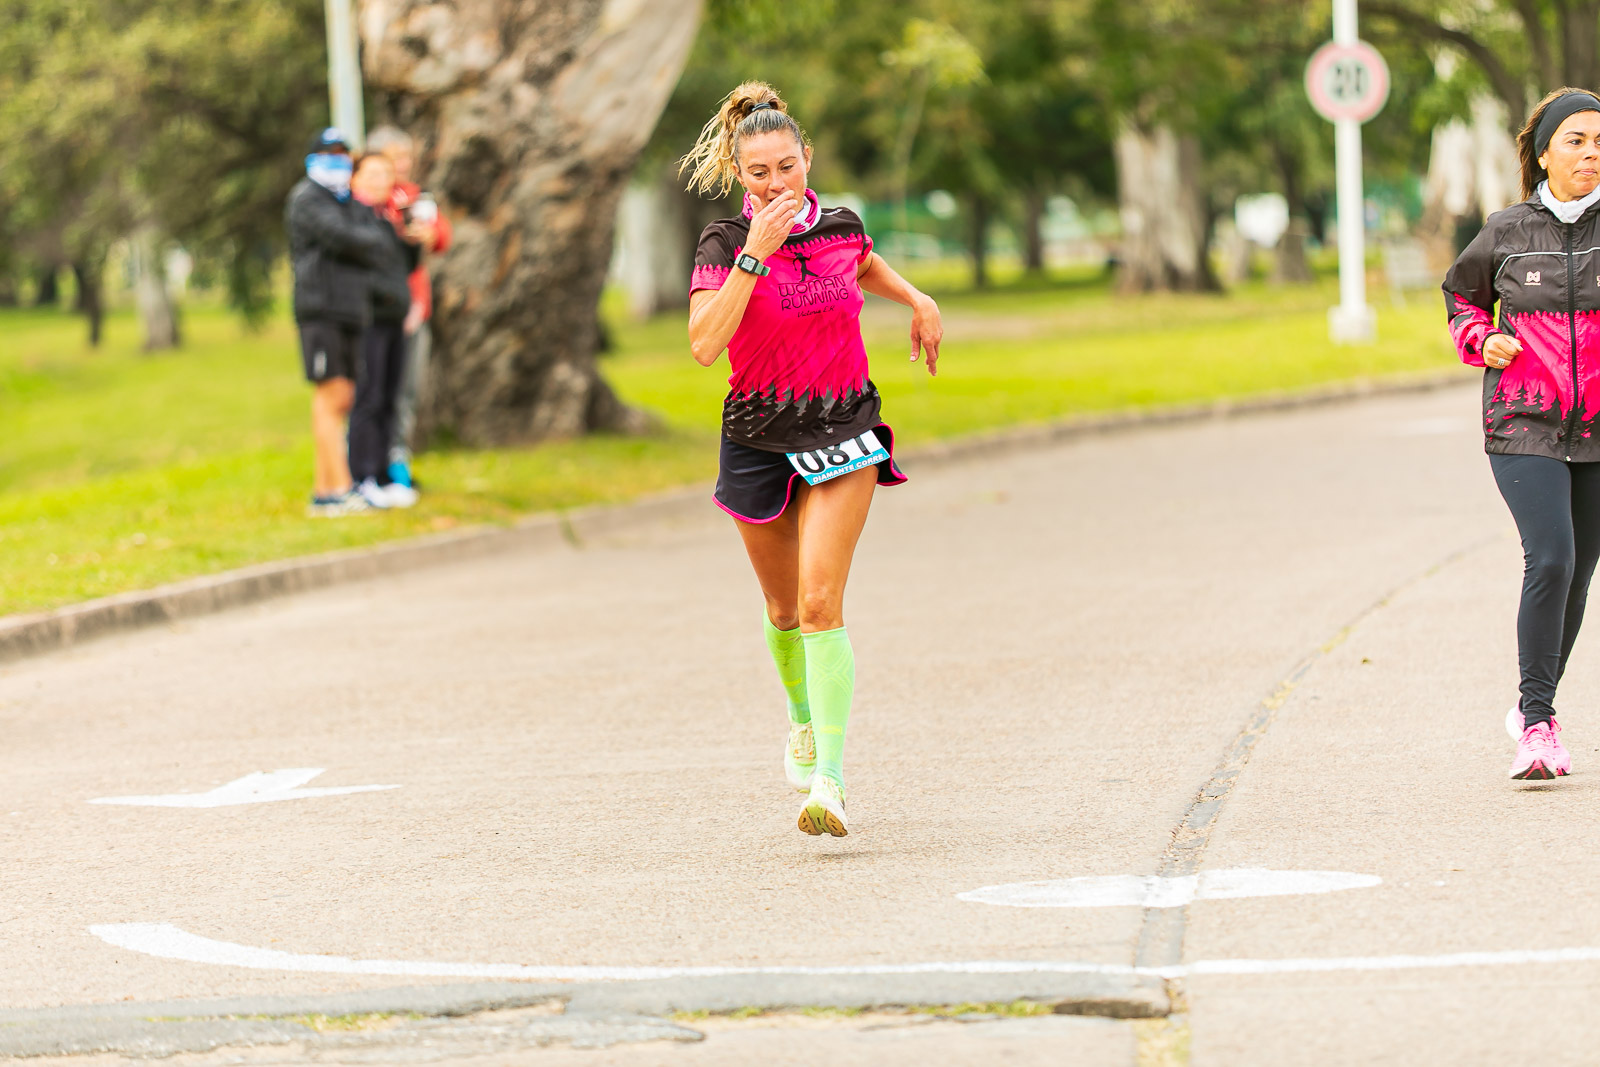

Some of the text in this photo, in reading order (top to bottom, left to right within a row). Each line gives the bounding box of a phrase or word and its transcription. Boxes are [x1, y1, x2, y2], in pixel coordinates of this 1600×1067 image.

[778, 276, 846, 297] WOMAN
[781, 288, 849, 311] RUNNING
[812, 453, 884, 484] DIAMANTE CORRE
